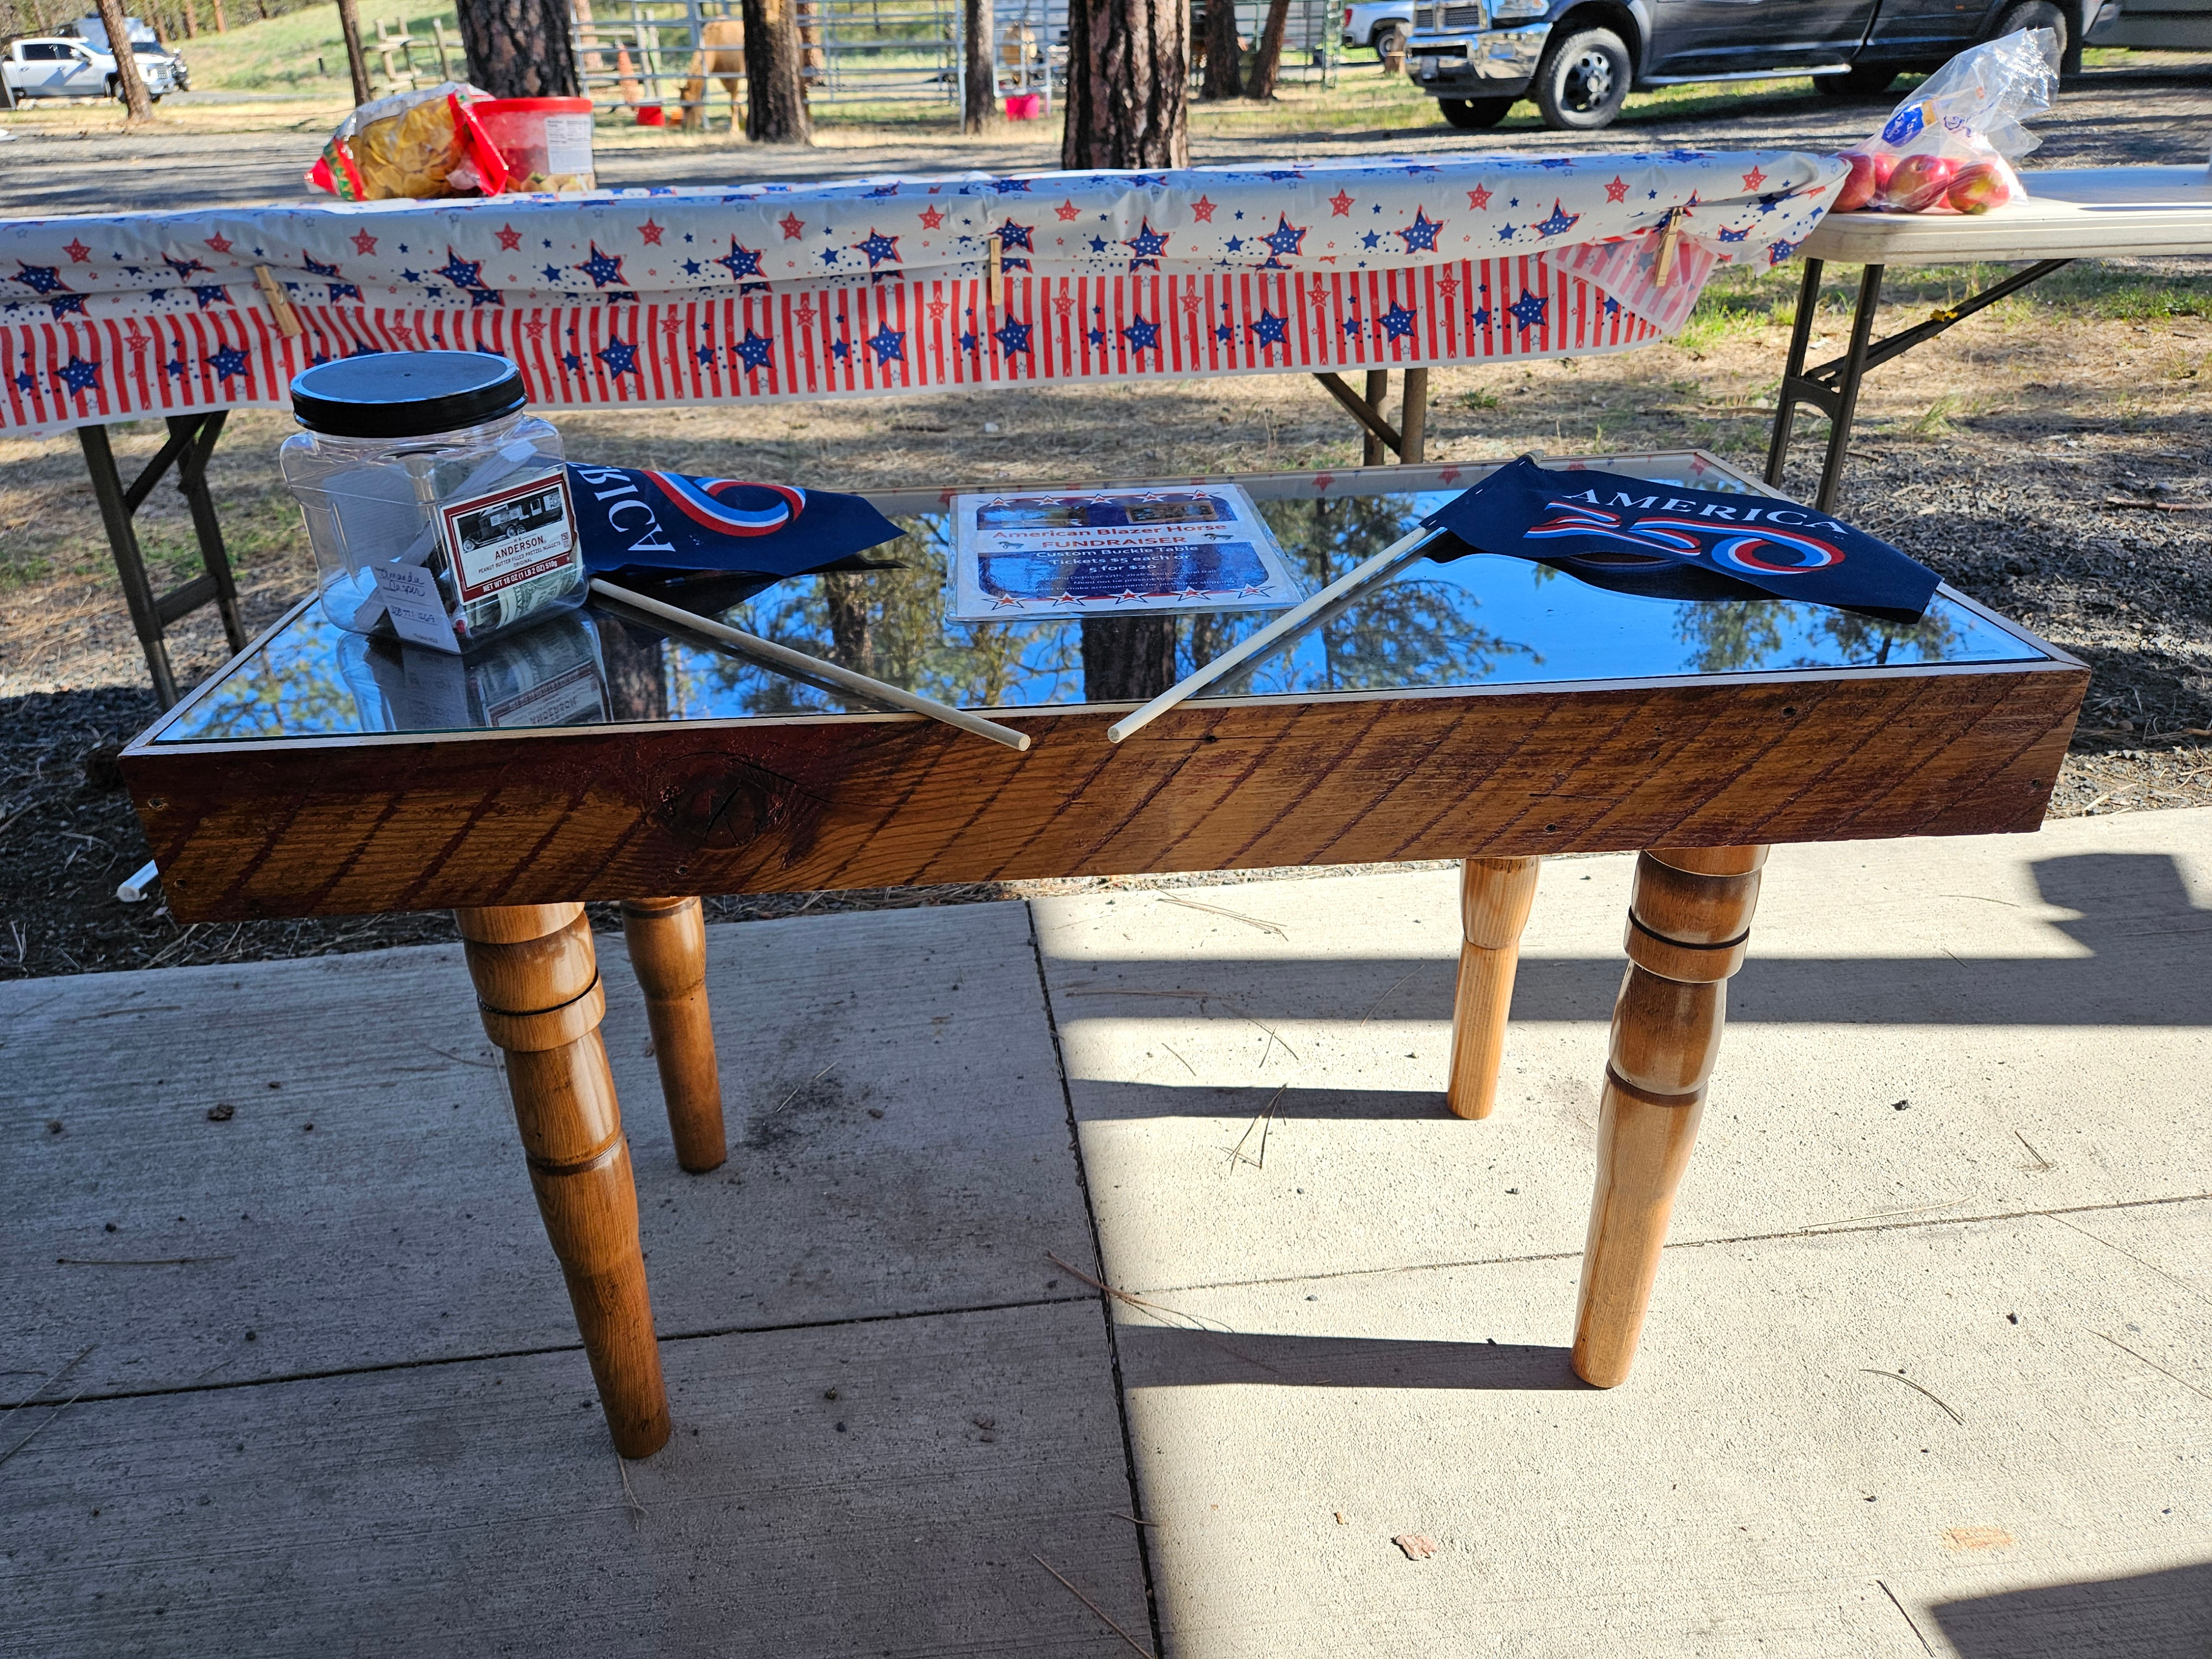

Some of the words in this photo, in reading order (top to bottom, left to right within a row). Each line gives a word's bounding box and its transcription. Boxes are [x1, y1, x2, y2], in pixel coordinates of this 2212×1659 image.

[1562, 489, 1849, 535] AMERICA
[495, 535, 544, 560] ANDERSON
[993, 530, 1091, 539] American
[1042, 536, 1187, 548] FUNDRAISER
[1523, 501, 1846, 575] 250
[478, 565, 494, 574] PEANUT
[495, 559, 511, 568] BUTTER
[512, 554, 525, 562] FILLED
[525, 547, 542, 556] PRETZEL
[542, 541, 561, 551] NUGGETS
[513, 557, 533, 567] ORIGINAL
[483, 583, 493, 592] NET
[494, 580, 503, 588] WT
[503, 576, 510, 585] 18
[511, 573, 518, 582] OZ
[519, 571, 524, 580] (1
[525, 568, 531, 577] LB
[546, 560, 558, 570] 510g
